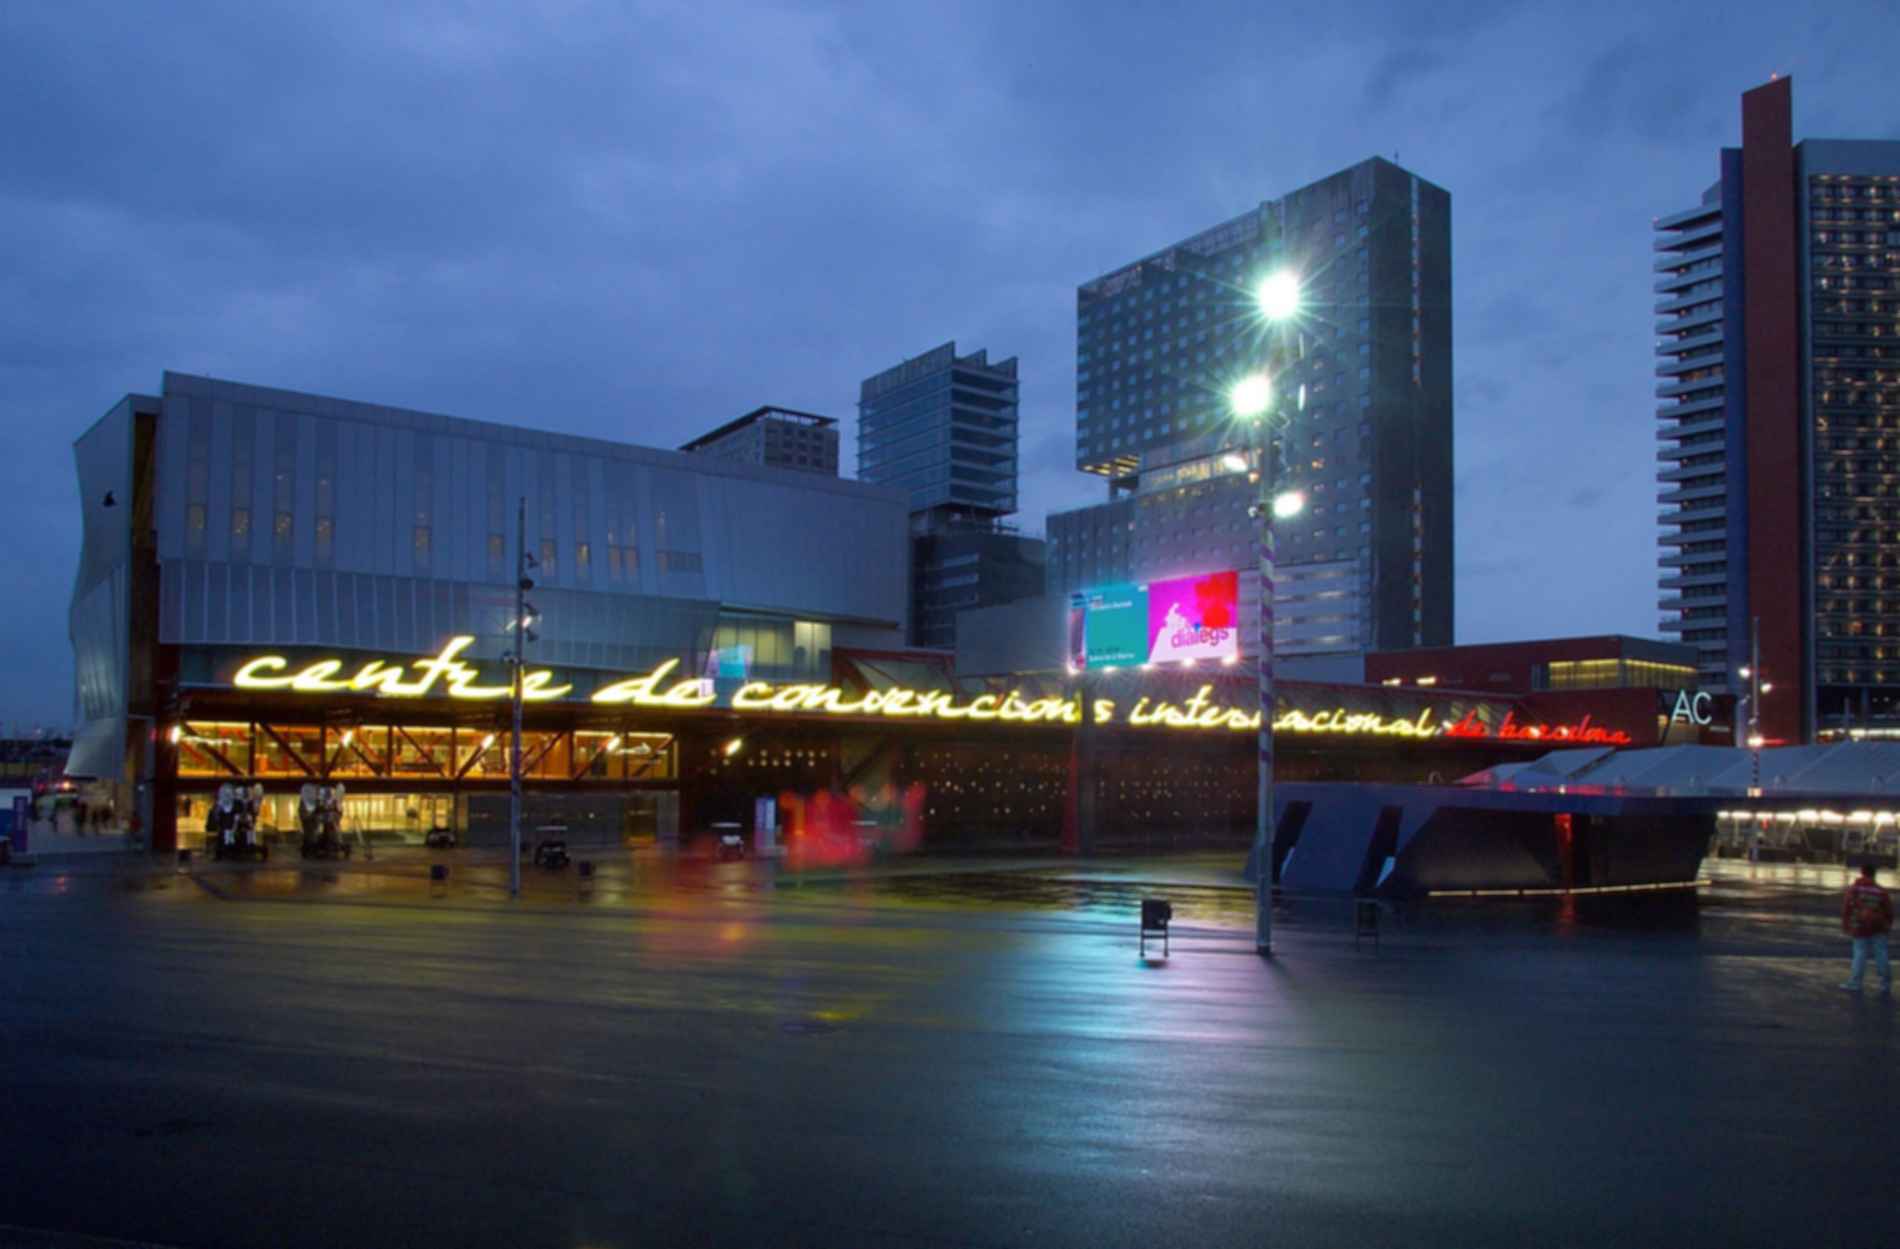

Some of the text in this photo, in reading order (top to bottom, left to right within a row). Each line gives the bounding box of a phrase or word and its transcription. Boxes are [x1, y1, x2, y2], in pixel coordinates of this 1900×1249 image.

[234, 636, 573, 702] centre
[591, 657, 718, 707] de
[732, 680, 1115, 724] convencions
[1671, 688, 1713, 725] AC
